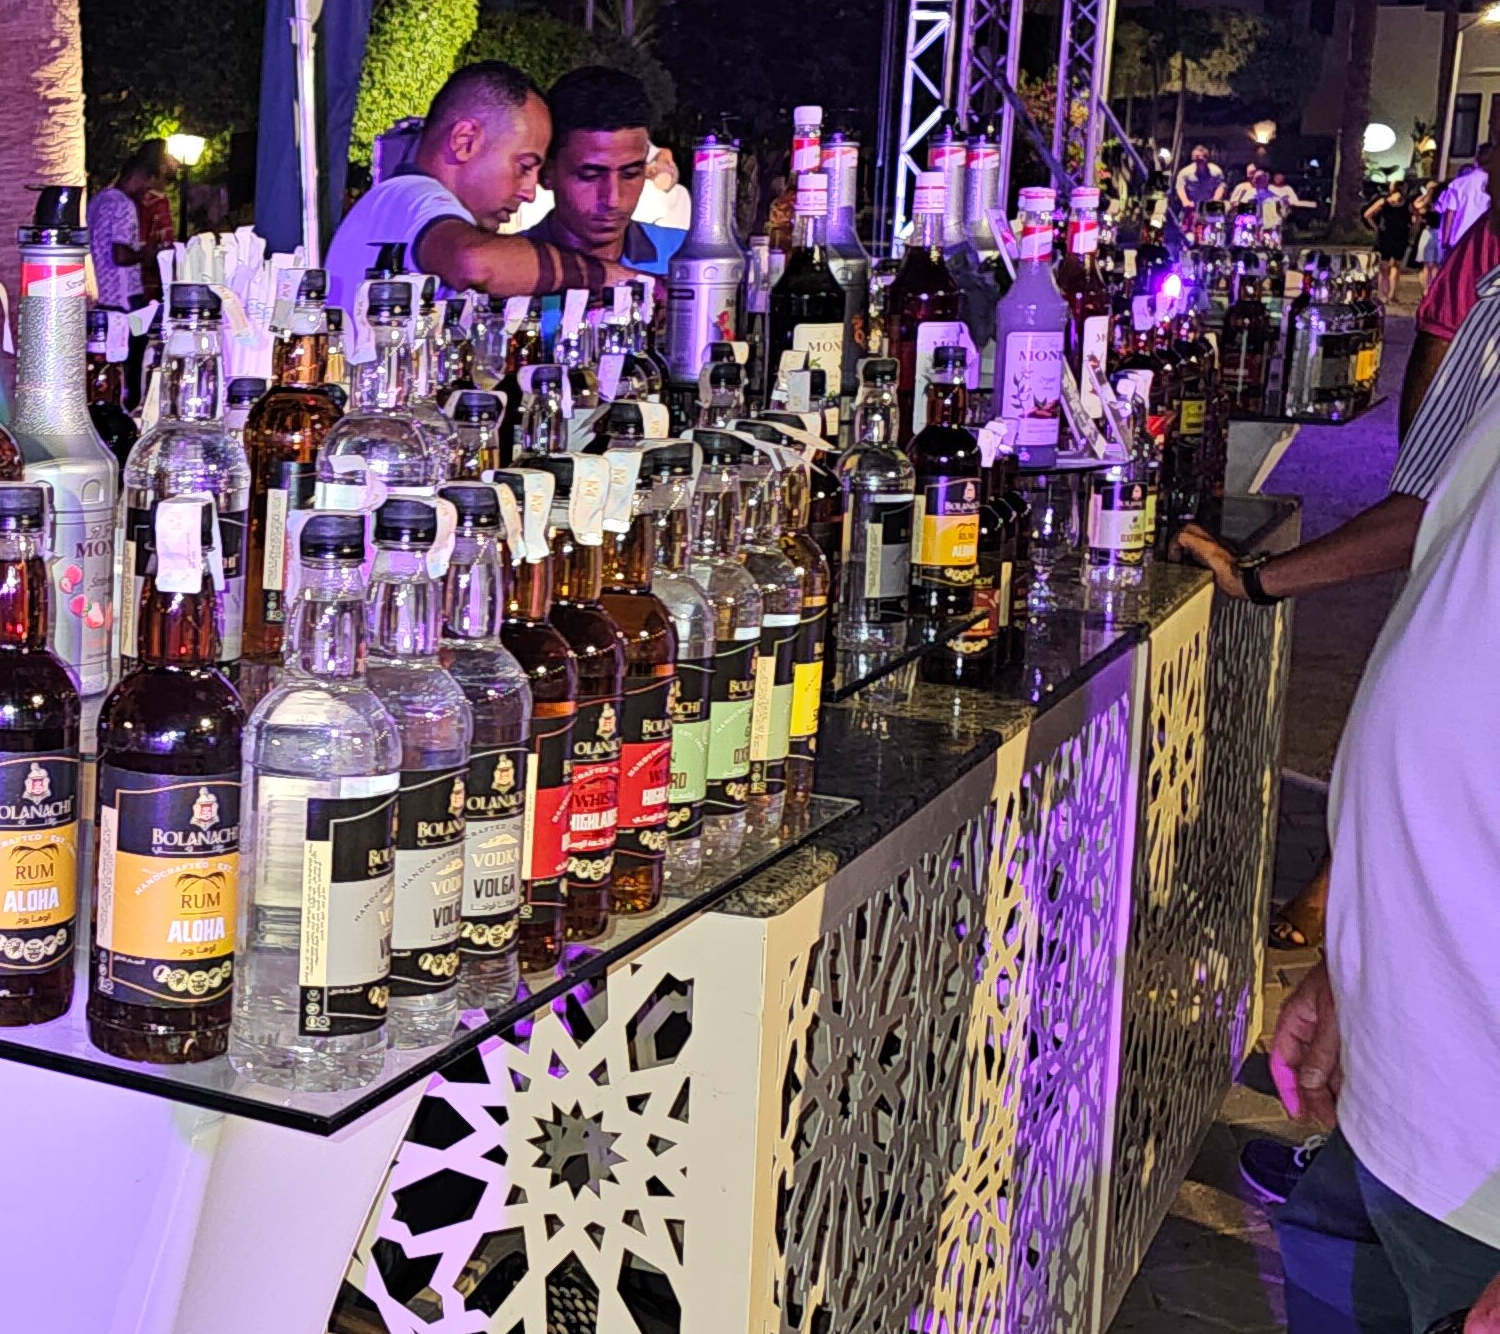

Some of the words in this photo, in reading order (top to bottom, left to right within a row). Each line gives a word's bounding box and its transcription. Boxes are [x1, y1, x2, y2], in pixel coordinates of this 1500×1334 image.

[16, 863, 54, 879] RUM
[135, 861, 209, 896] HANDCRAFTED
[473, 874, 516, 899] VOLGA
[3, 887, 60, 912] ALOHA
[181, 892, 221, 909] RUM
[167, 917, 226, 943] ALOHA
